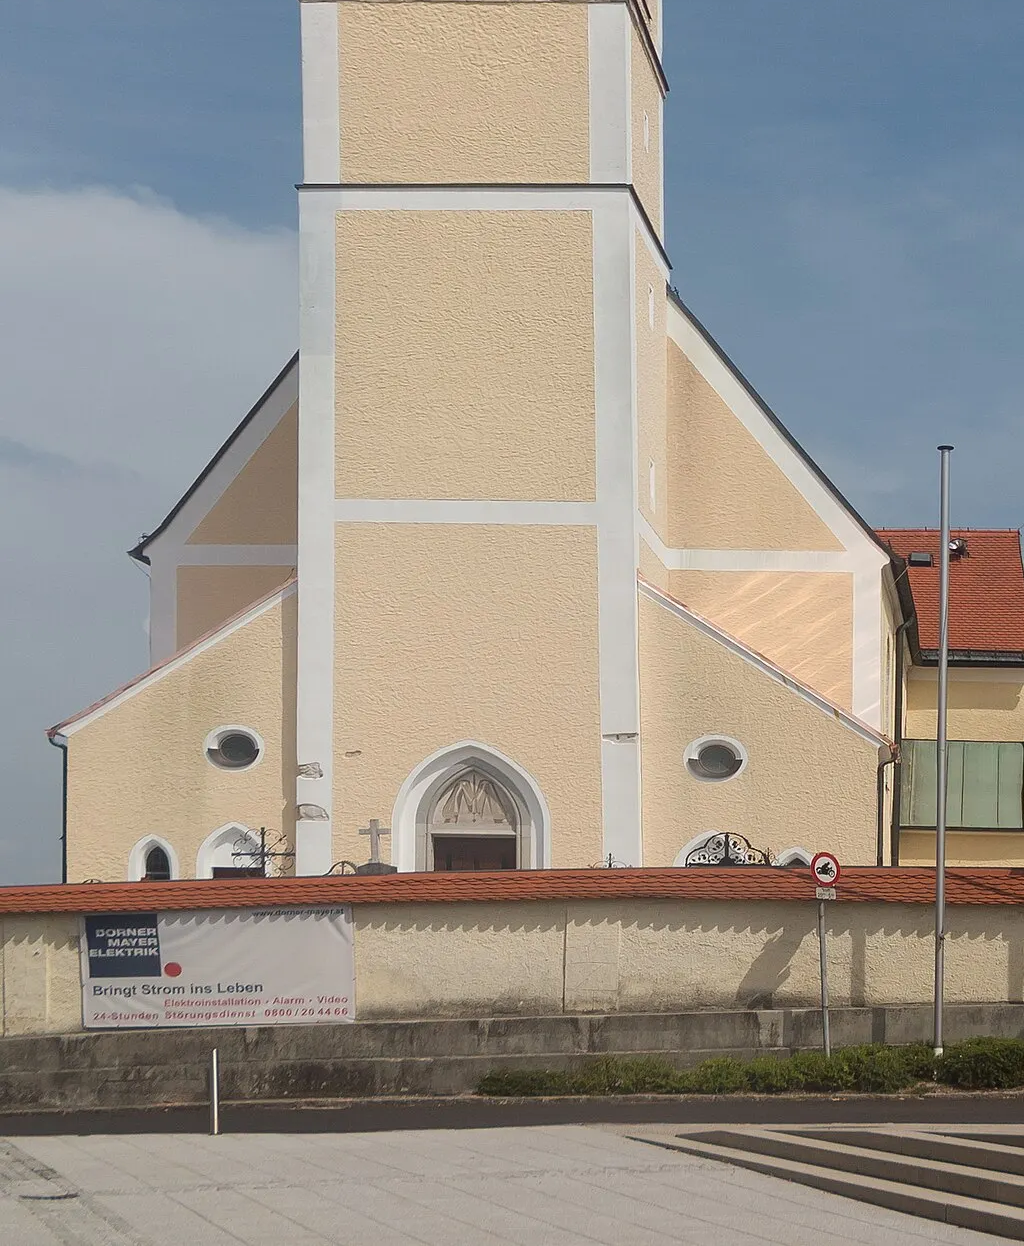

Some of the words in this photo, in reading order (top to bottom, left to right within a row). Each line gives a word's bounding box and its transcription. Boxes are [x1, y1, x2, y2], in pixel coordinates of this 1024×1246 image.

[95, 927, 157, 938] DORNER
[108, 937, 158, 947] MAYER
[89, 947, 159, 957] ELEKTRIK
[92, 984, 137, 997] Bringt
[141, 984, 185, 995] Strom
[190, 983, 212, 994] ins
[217, 982, 264, 993] Leben
[164, 997, 261, 1008] Elektroinstallation
[272, 996, 305, 1005] Alarm
[316, 995, 349, 1004] Video
[92, 1011, 159, 1021] 24-Stunden
[164, 1010, 256, 1021] Störungsdienst
